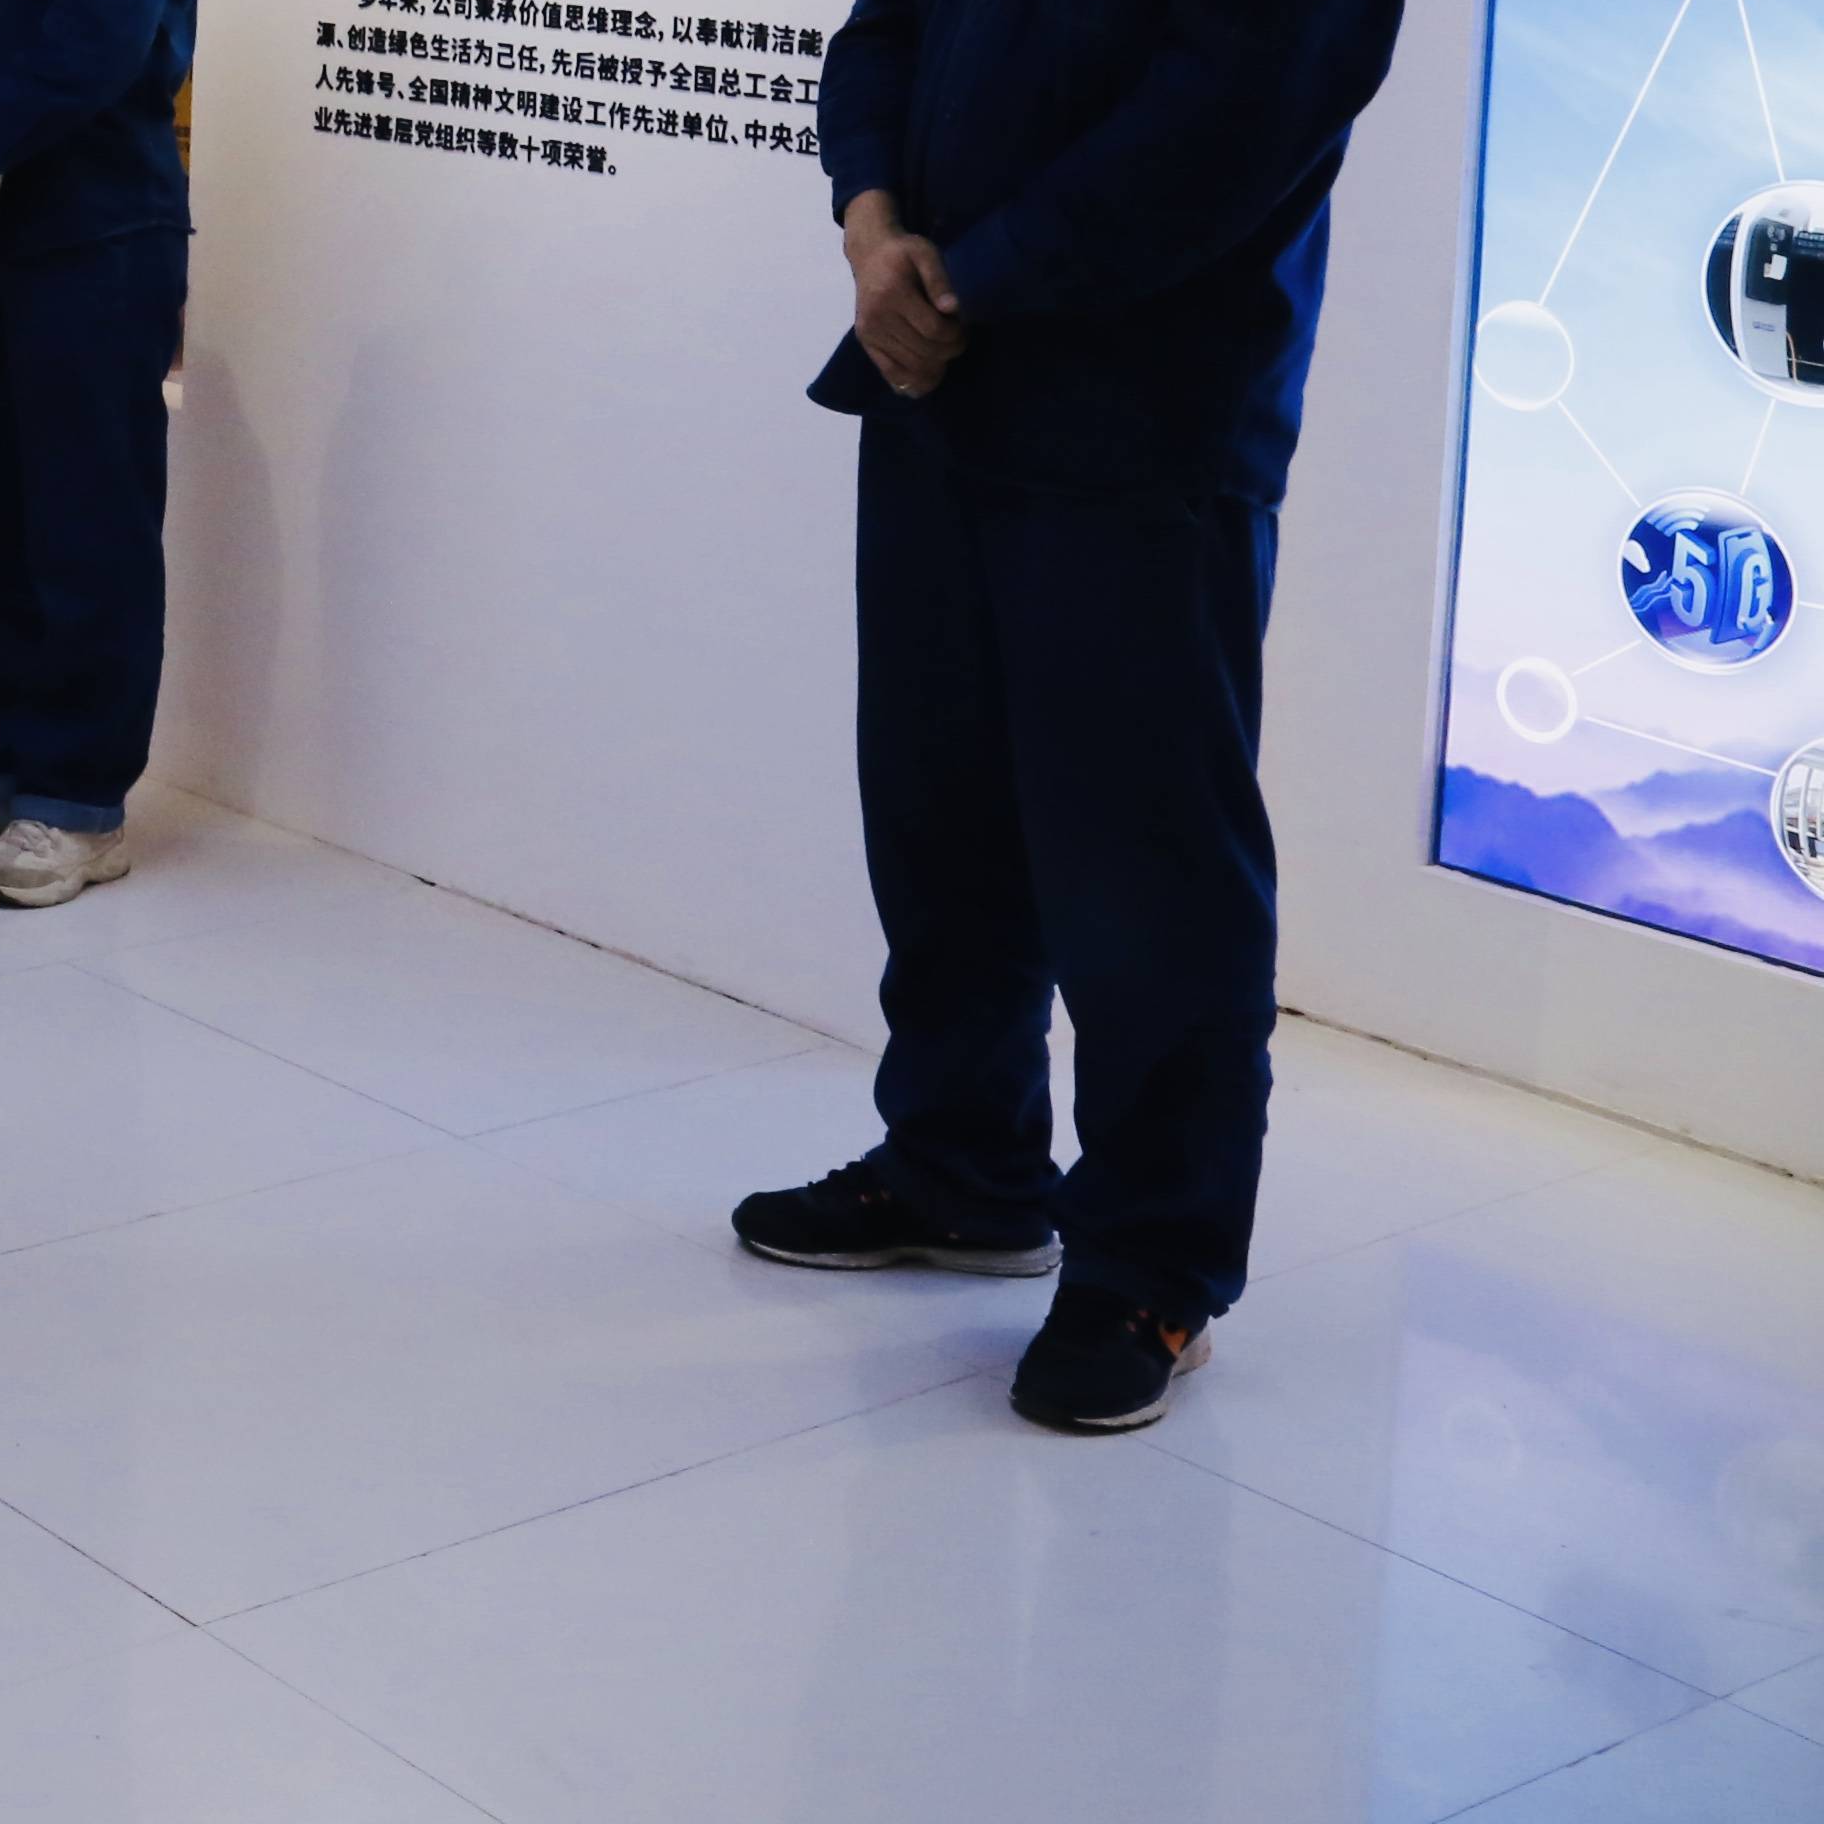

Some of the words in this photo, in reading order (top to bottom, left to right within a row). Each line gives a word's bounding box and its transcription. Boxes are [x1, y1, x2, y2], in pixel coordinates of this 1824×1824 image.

[314, 107, 618, 176] 业先进基层党组织等数十项荣誉。
